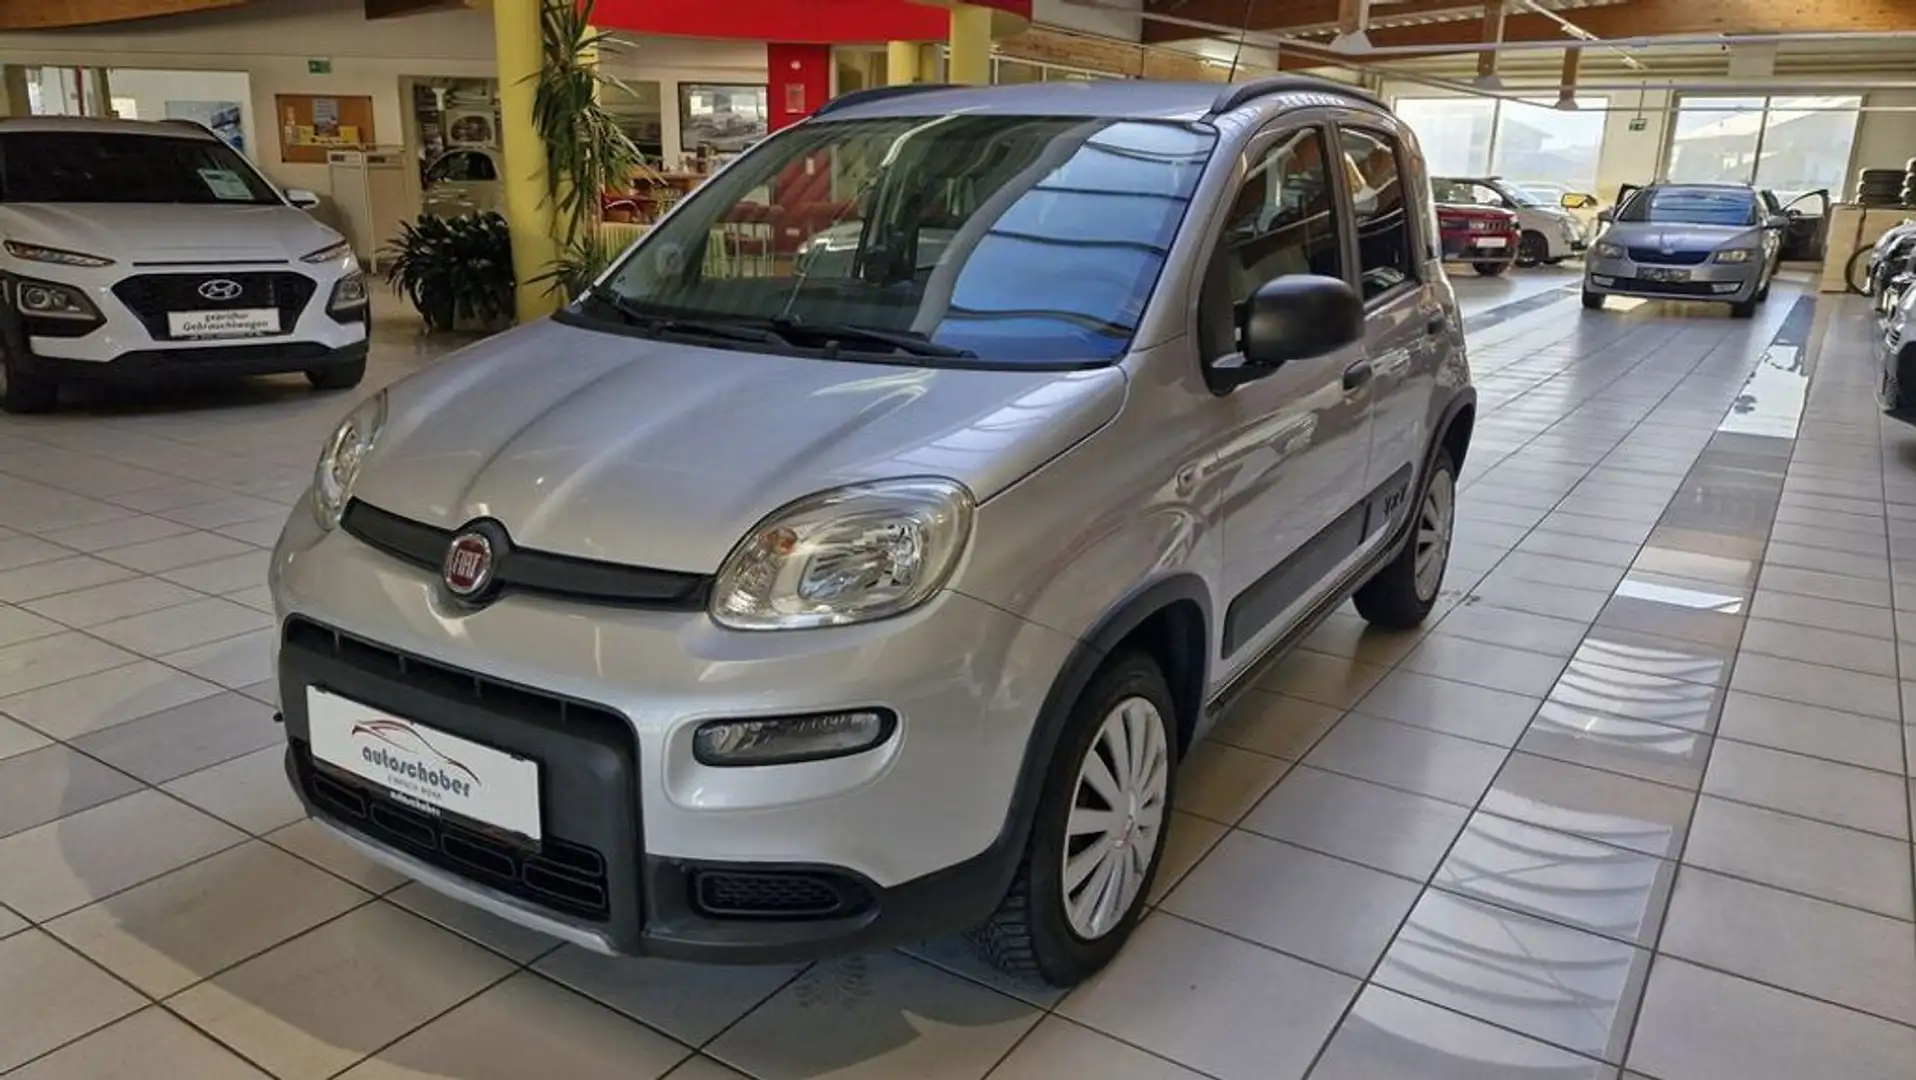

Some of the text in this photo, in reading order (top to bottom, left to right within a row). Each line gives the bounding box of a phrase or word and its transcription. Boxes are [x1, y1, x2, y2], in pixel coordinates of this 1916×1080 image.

[183, 320, 269, 331] Gebrauchtwagen
[451, 549, 483, 579] FIAT
[362, 744, 471, 798] autoschober
